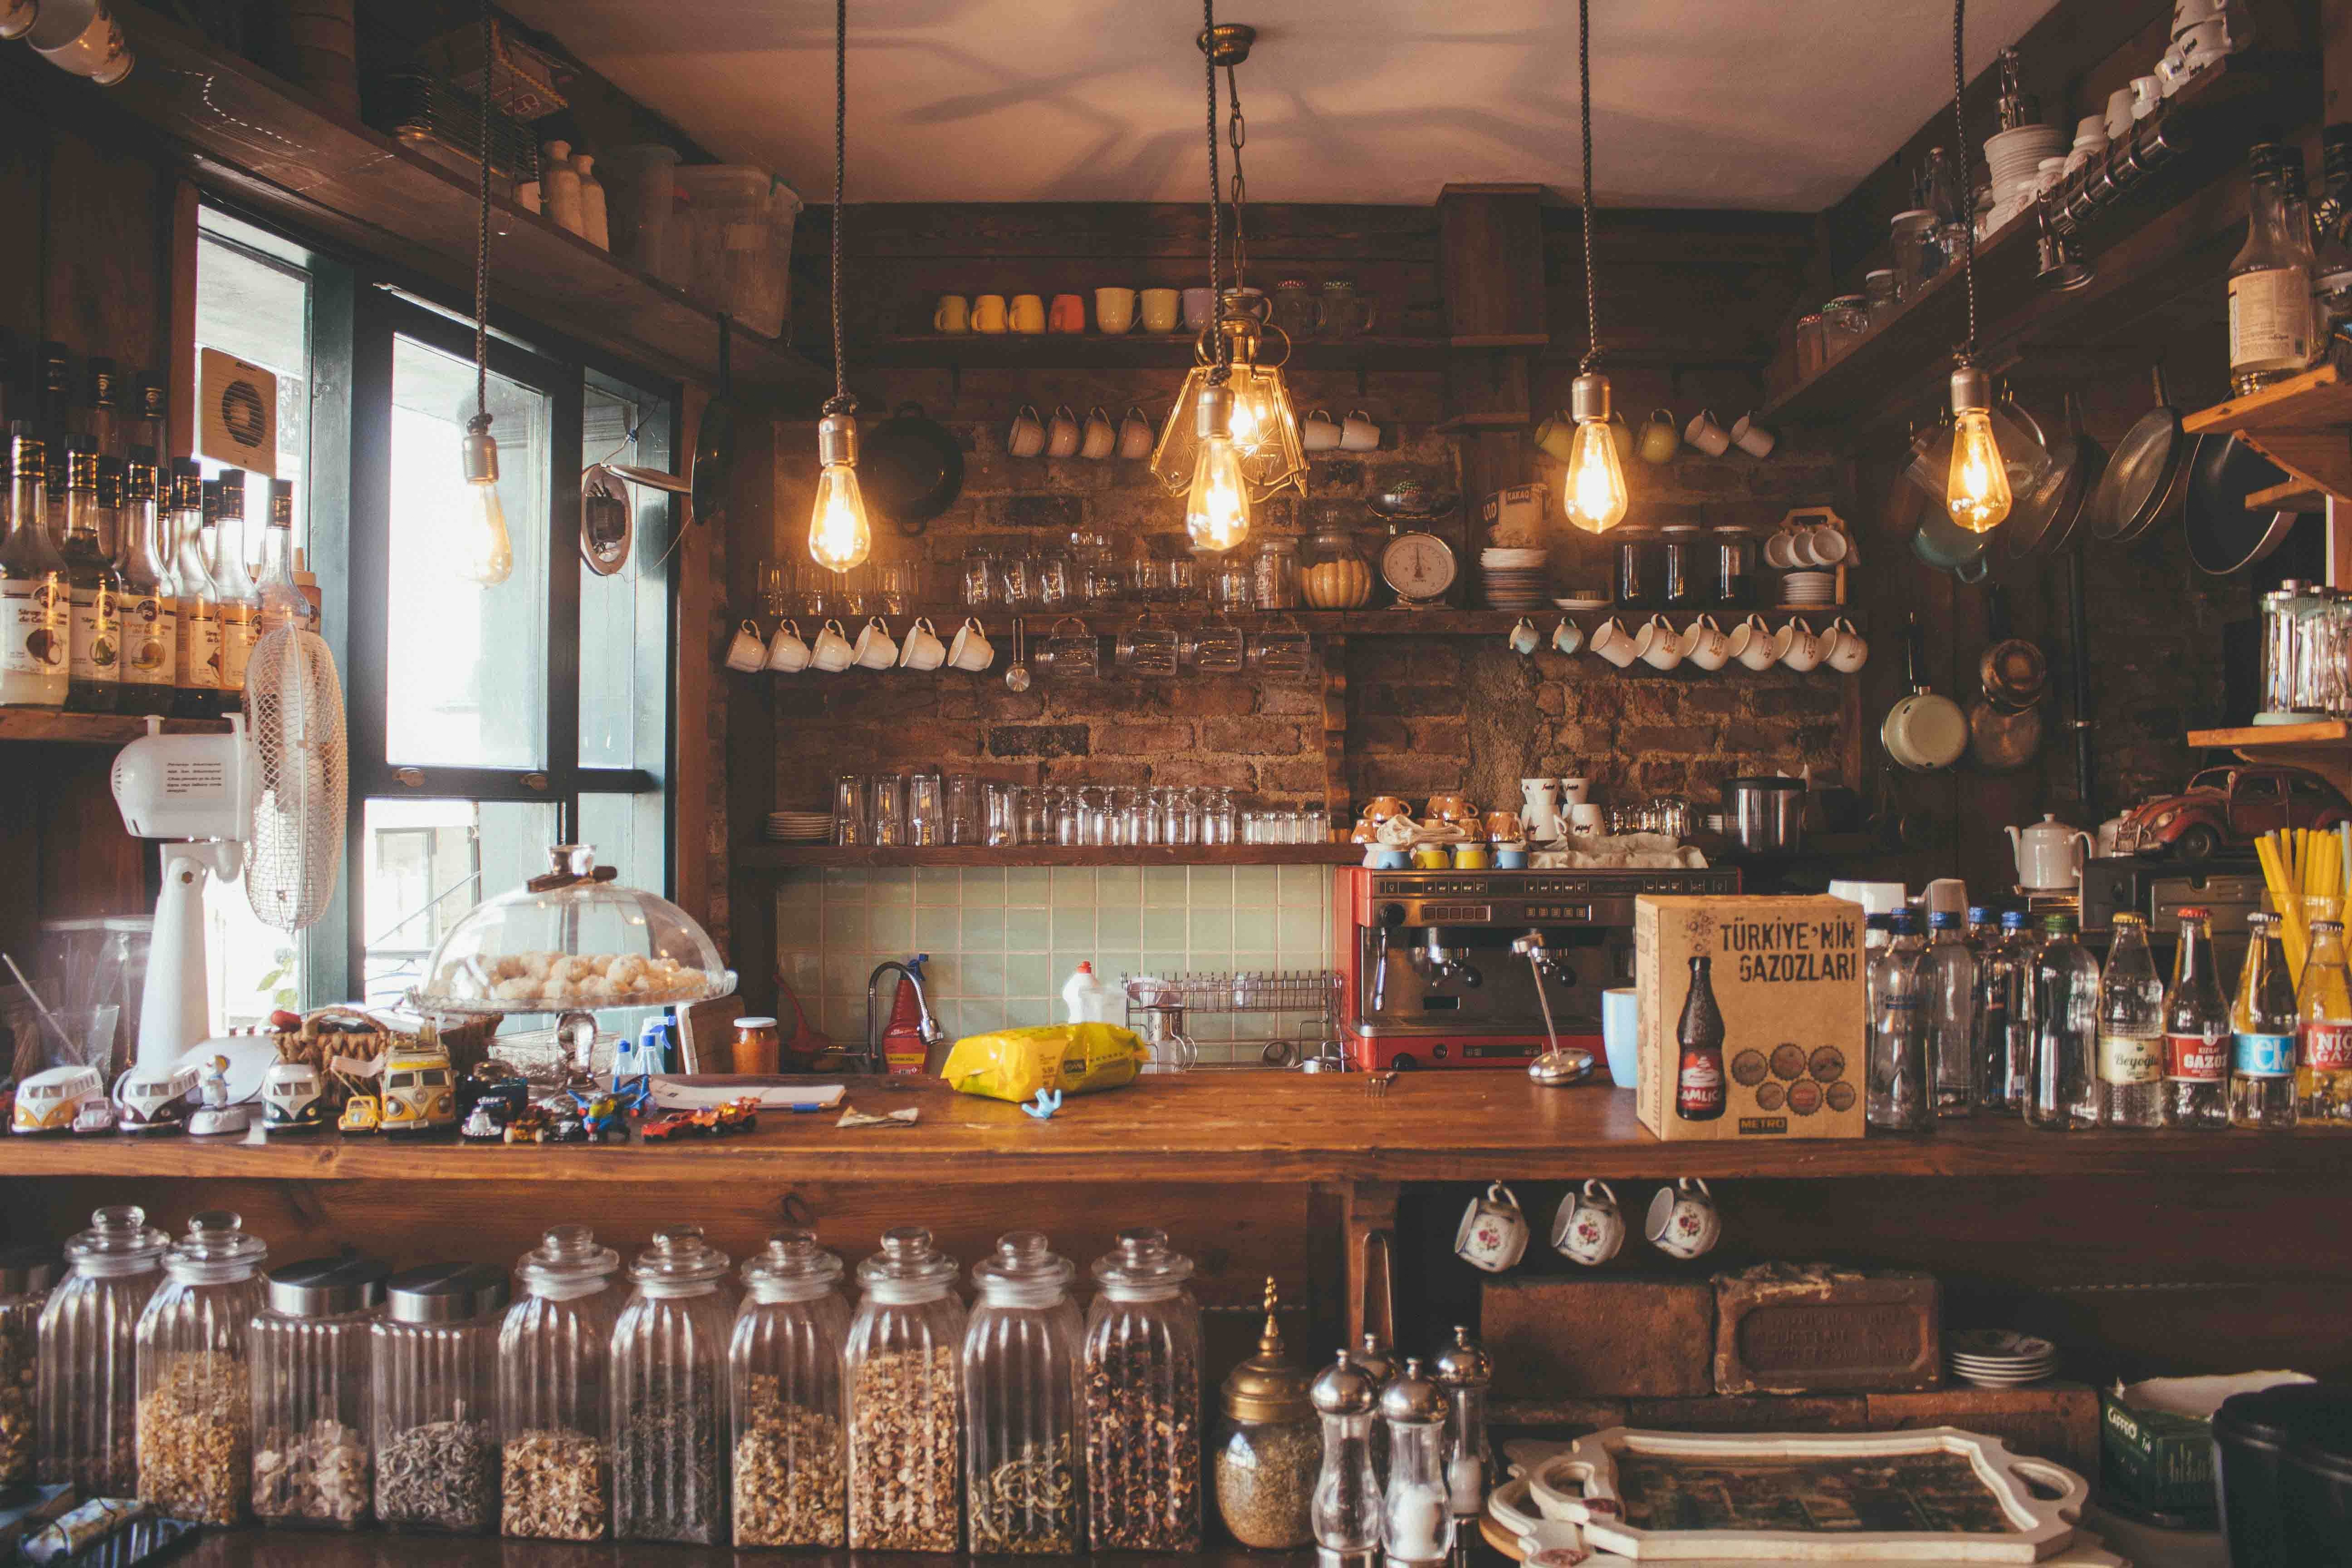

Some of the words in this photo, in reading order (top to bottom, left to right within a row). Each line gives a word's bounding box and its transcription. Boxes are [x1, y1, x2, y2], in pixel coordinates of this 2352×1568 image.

[1720, 915, 1855, 951] TÜRKİYE'NİN
[1740, 953, 1857, 982] GAZOZLARI
[1742, 1120, 1784, 1129] METRO
